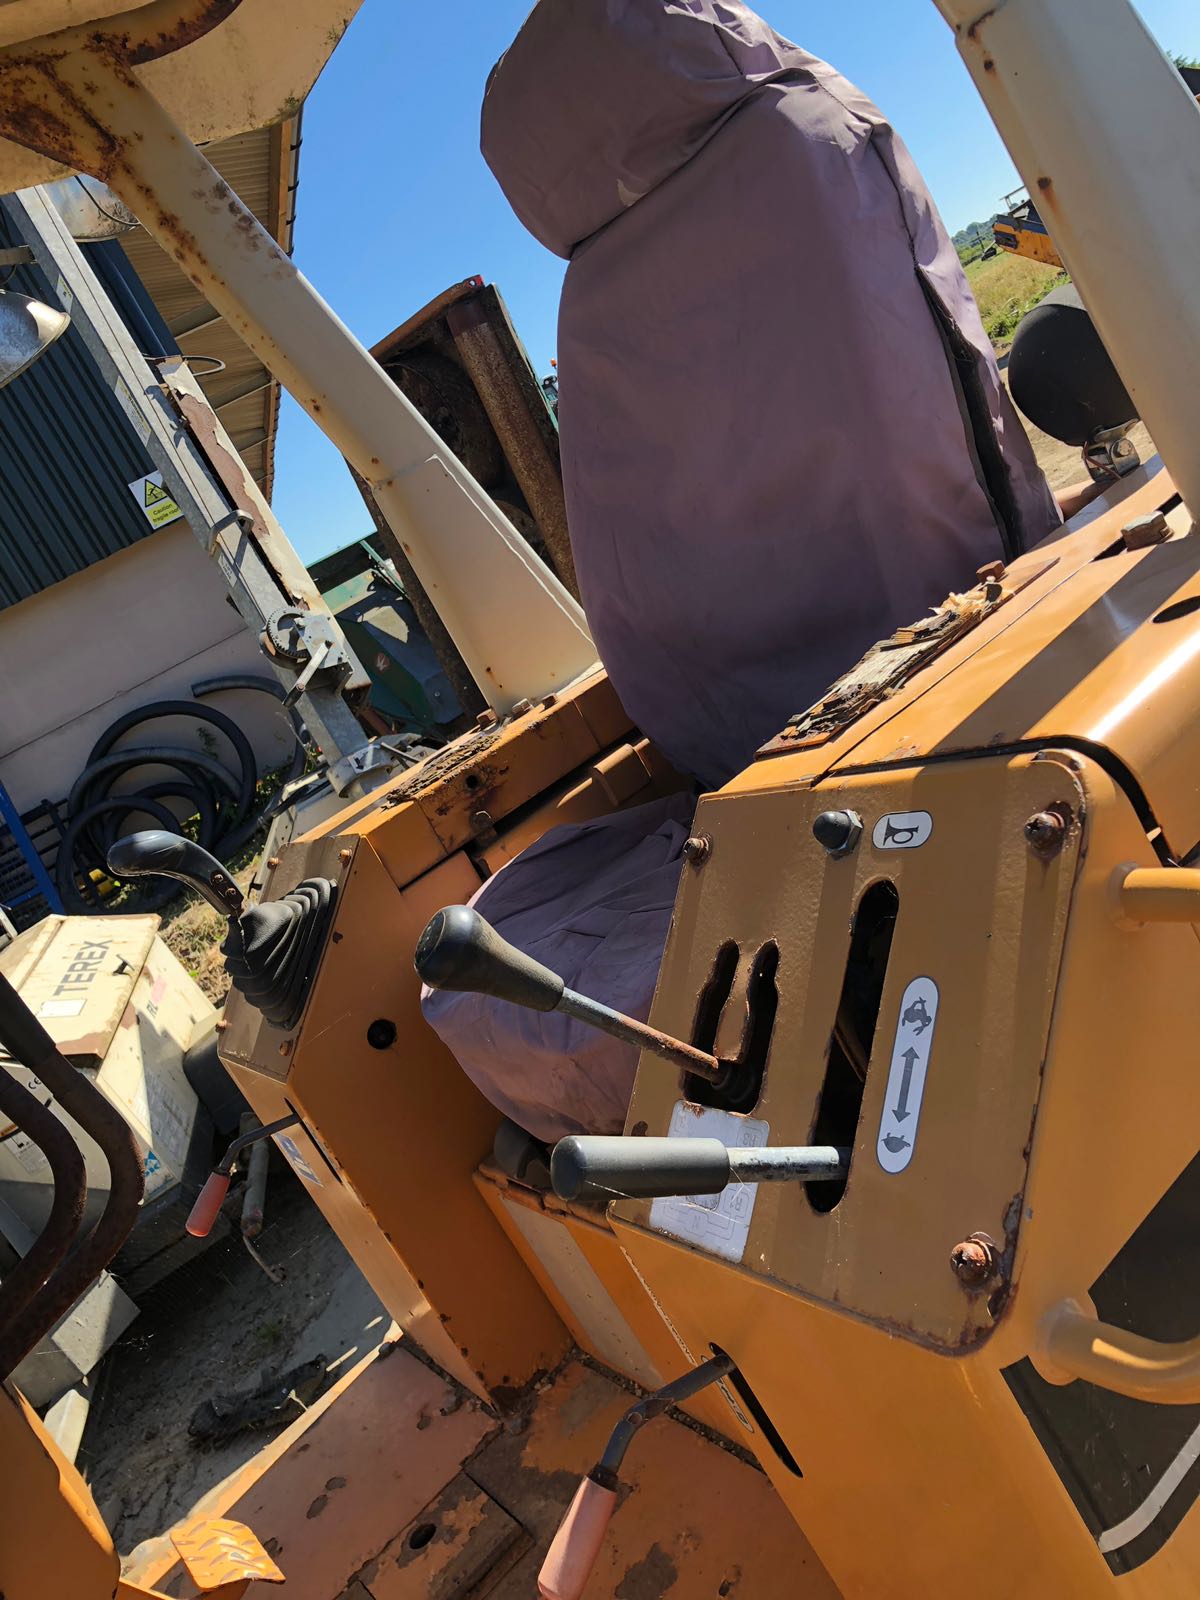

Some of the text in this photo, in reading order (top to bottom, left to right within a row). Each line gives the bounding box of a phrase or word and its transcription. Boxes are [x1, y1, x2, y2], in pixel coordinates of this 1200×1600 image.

[152, 503, 174, 516] Caution
[152, 512, 169, 523] fragile
[53, 939, 113, 997] TEREX
